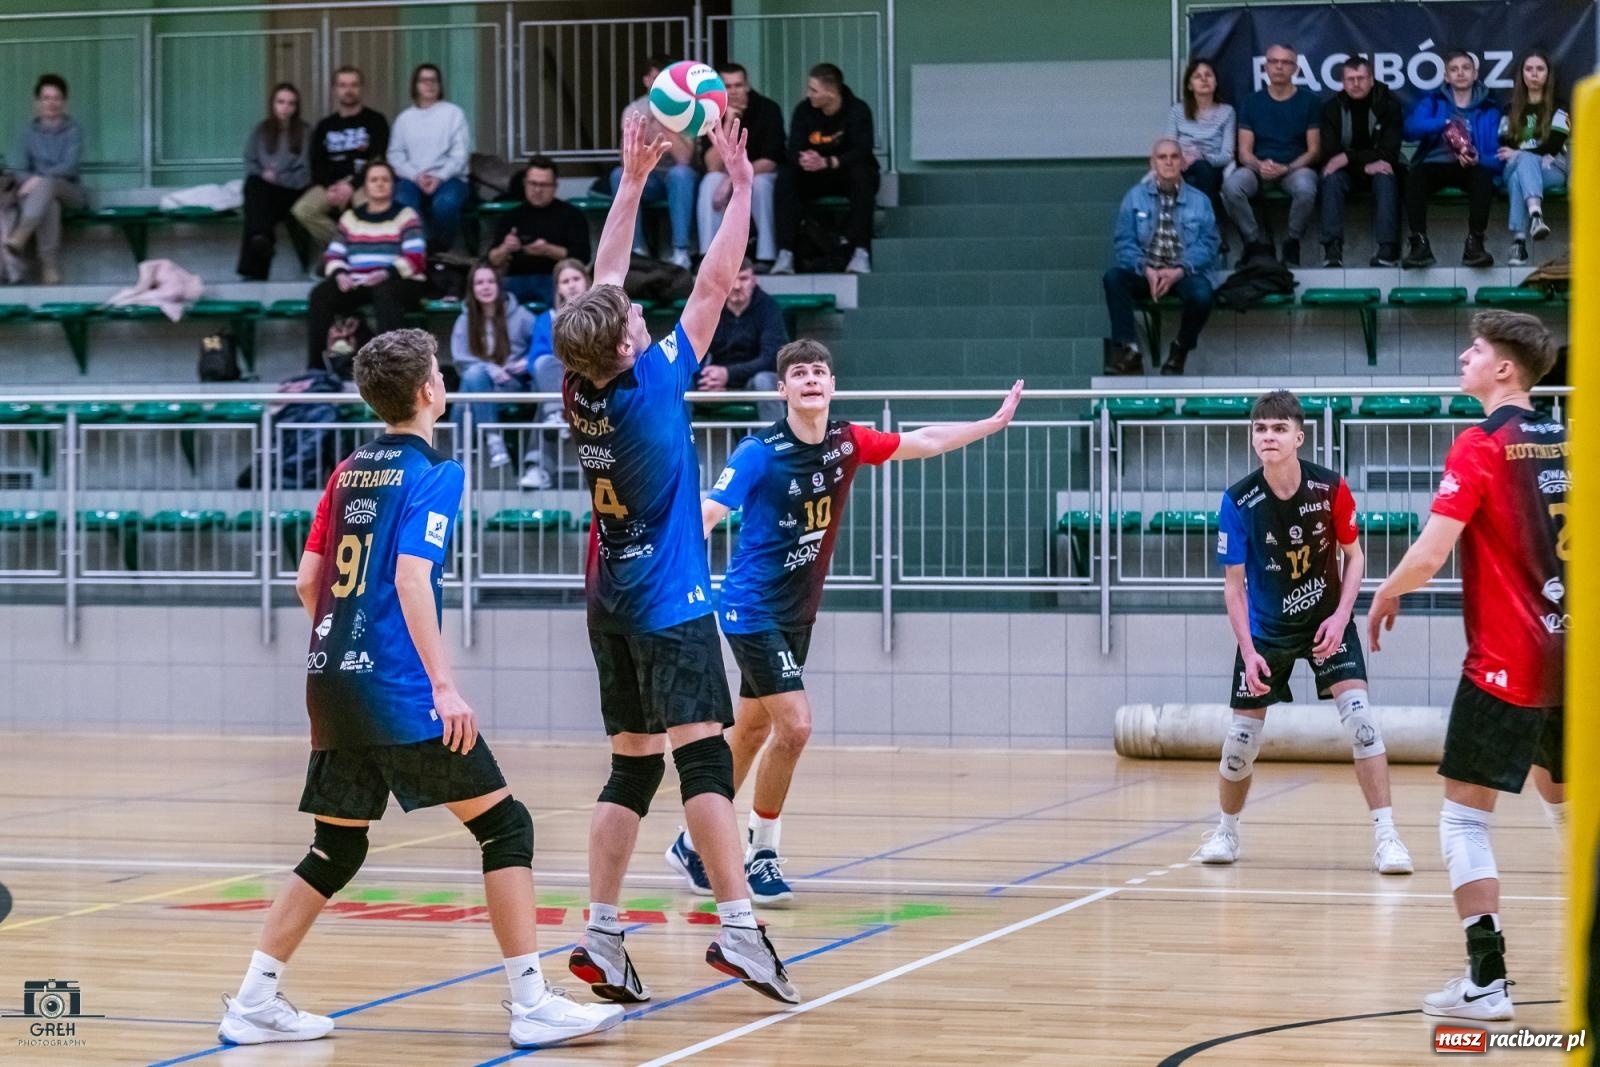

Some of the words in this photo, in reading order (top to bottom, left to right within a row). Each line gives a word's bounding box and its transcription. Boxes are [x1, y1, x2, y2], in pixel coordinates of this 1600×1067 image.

[1252, 38, 1514, 93] RACBÓZ
[354, 449, 375, 461] plus
[383, 449, 403, 460] liga
[335, 468, 405, 489] POTRAWA
[344, 498, 378, 516] NOWAK
[594, 477, 630, 521] 4
[1298, 501, 1323, 517] plus
[346, 514, 374, 525] MOSTY
[804, 495, 832, 532] 10
[331, 533, 374, 599] 91
[1286, 544, 1312, 580] 17
[1238, 672, 1248, 691] 1
